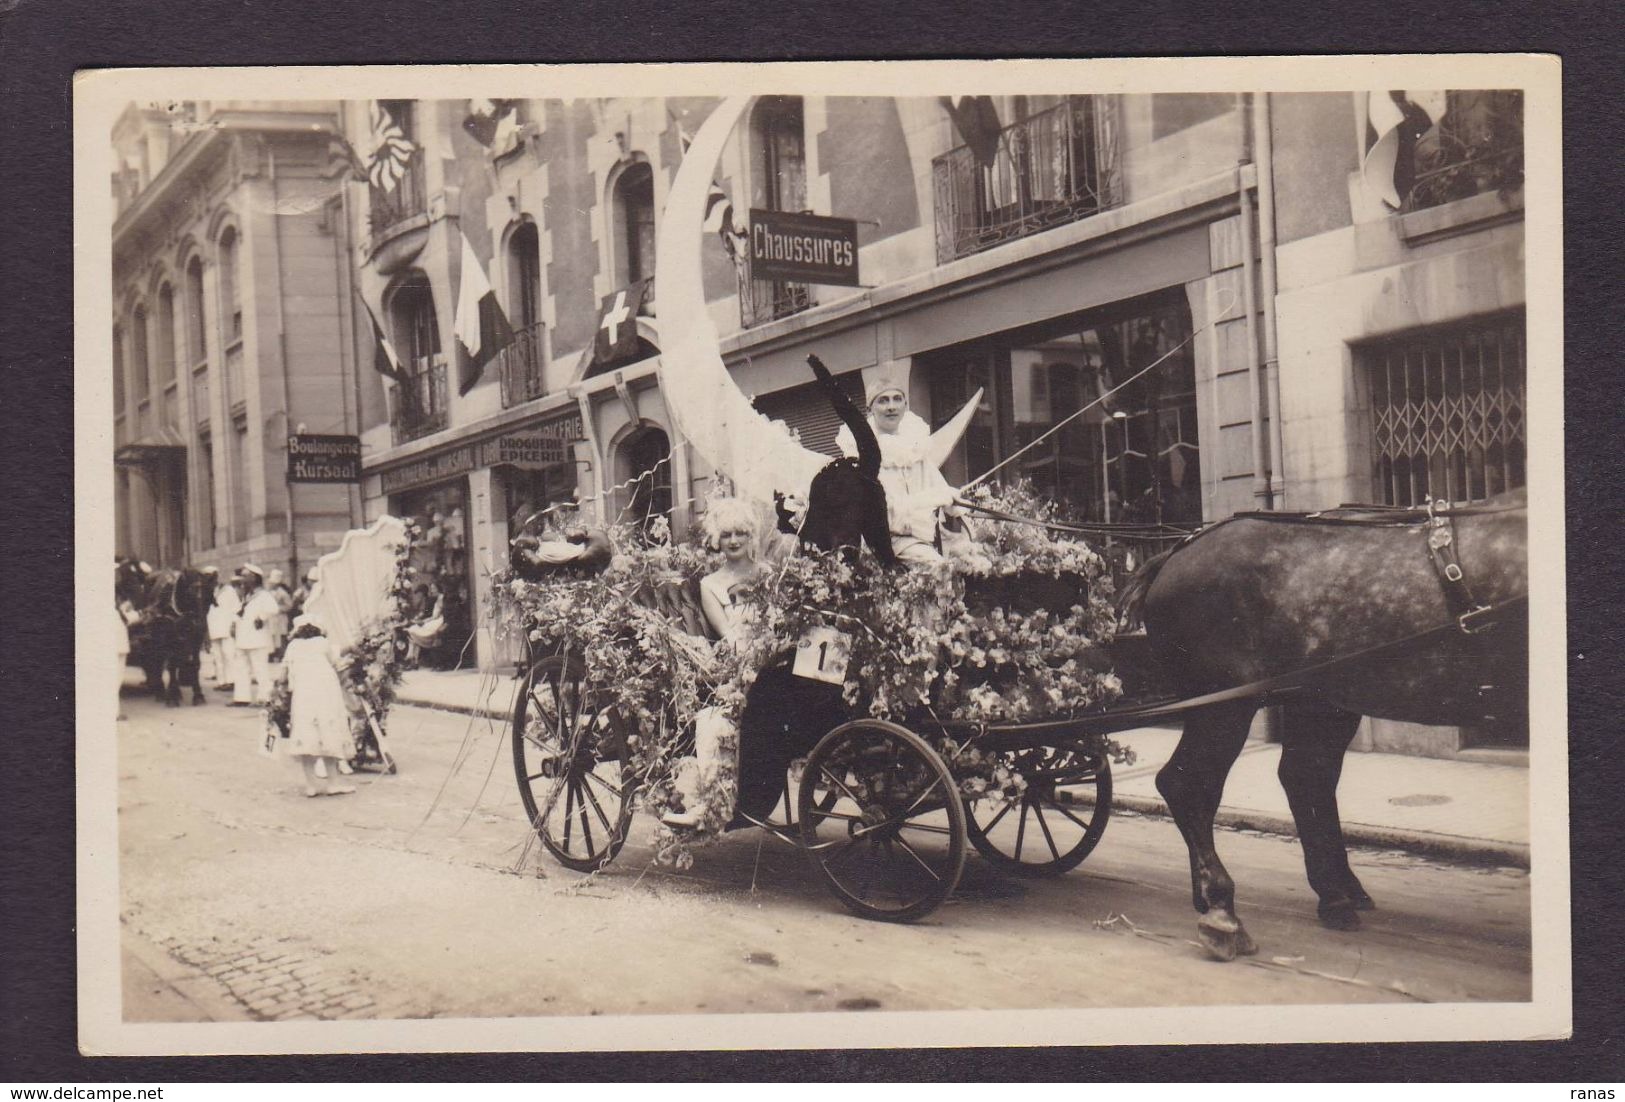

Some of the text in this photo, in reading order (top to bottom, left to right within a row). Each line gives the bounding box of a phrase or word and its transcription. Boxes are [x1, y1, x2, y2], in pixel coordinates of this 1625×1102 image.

[754, 223, 853, 267] Chaussures
[289, 436, 359, 458] Boulangerie
[500, 438, 563, 450] DROGUERIE
[500, 450, 564, 462] EPICERIE
[295, 460, 356, 478] Kursaal
[818, 641, 828, 671] 1
